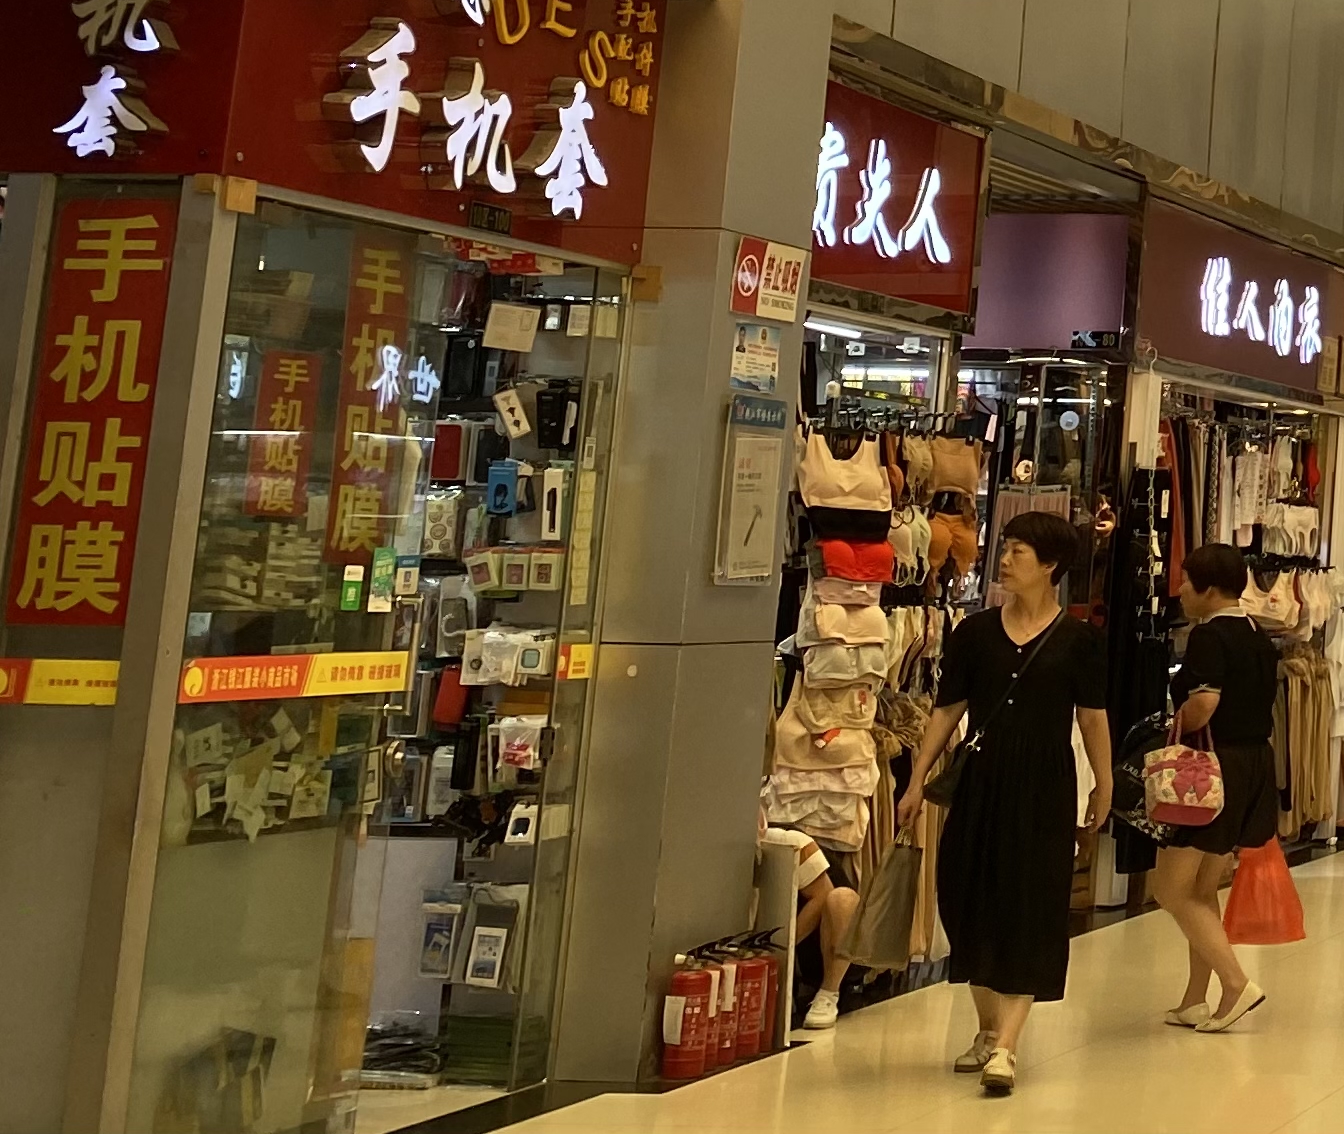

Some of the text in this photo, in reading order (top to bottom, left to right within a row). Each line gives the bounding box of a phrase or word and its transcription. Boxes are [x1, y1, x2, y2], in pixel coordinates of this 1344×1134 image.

[349, 21, 608, 220] 手机套
[15, 214, 164, 615] 手机贴膜
[256, 357, 311, 515] 手机贴膜
[330, 247, 405, 554] 手机贴膜
